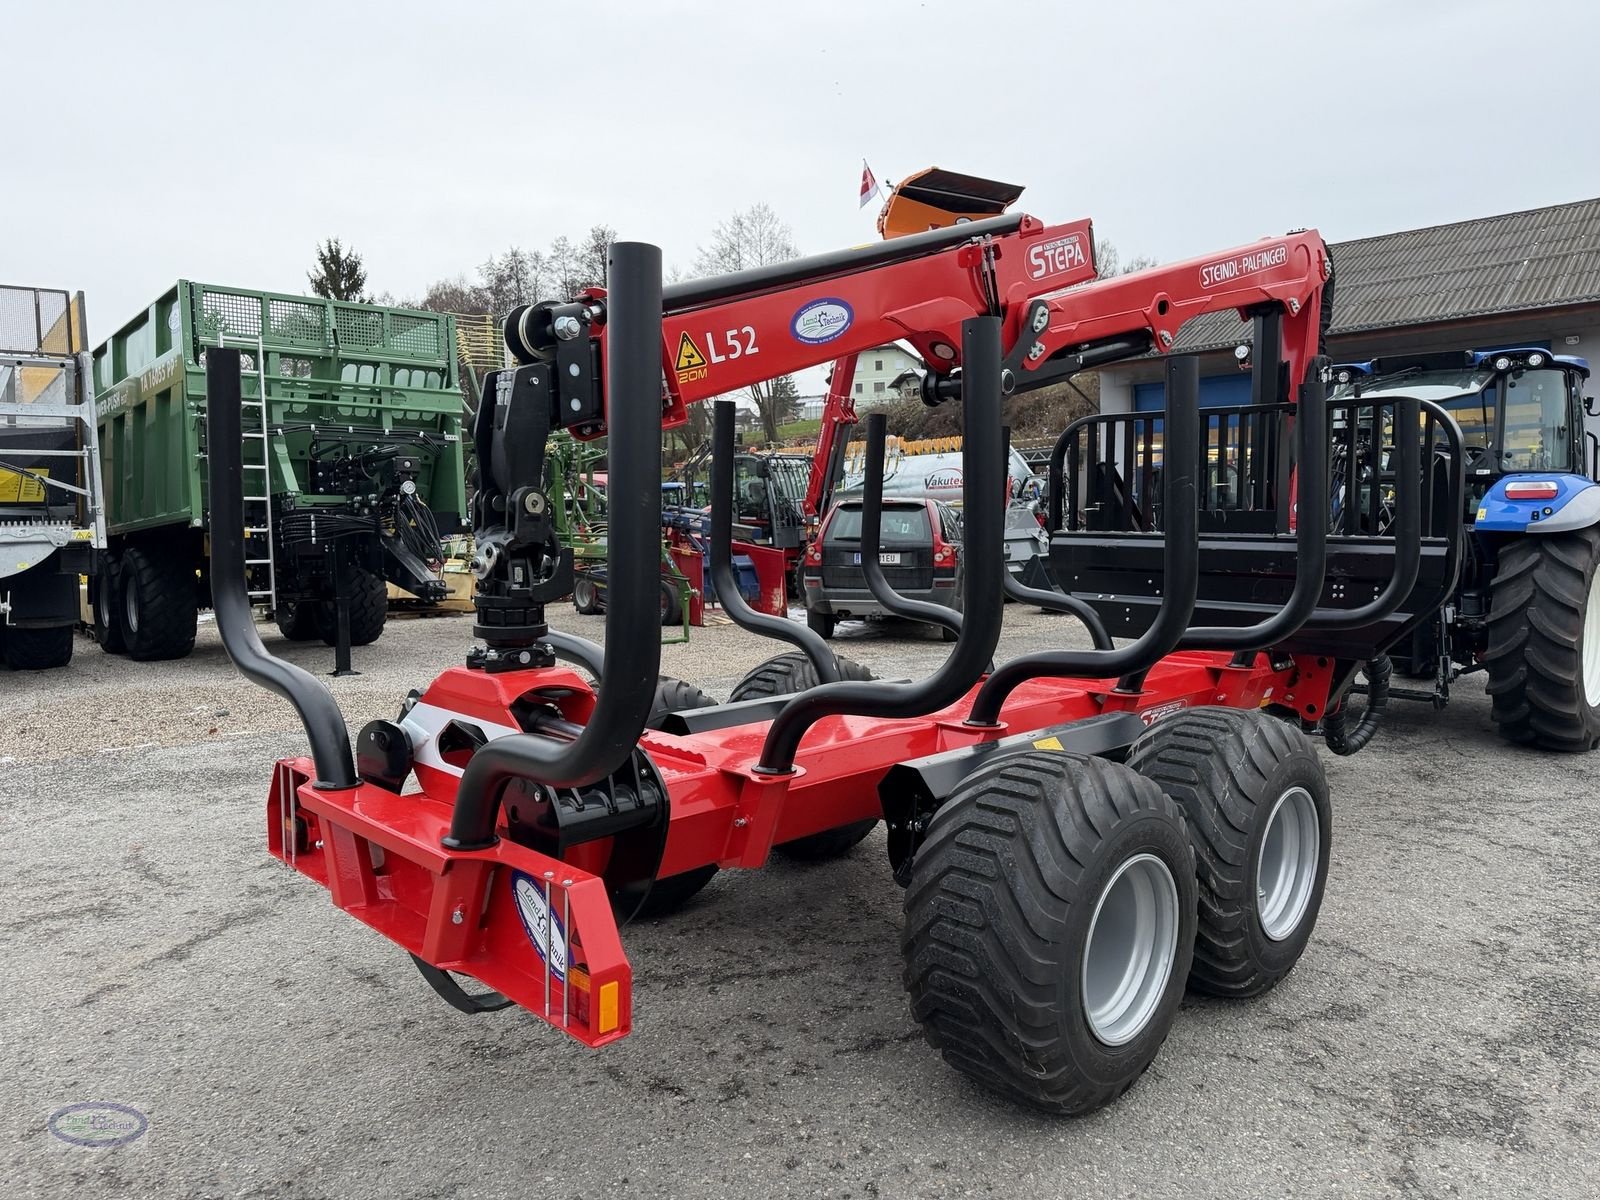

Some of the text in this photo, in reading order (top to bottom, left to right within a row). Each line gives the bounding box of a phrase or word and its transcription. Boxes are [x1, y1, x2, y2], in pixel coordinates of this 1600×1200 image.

[1030, 242, 1085, 279] STEPA
[1202, 247, 1286, 286] STEINDL-PALFINGER
[802, 312, 846, 327] Land Technik
[705, 325, 760, 364] L52
[879, 554, 896, 562] 1EU
[523, 887, 542, 917] Land
